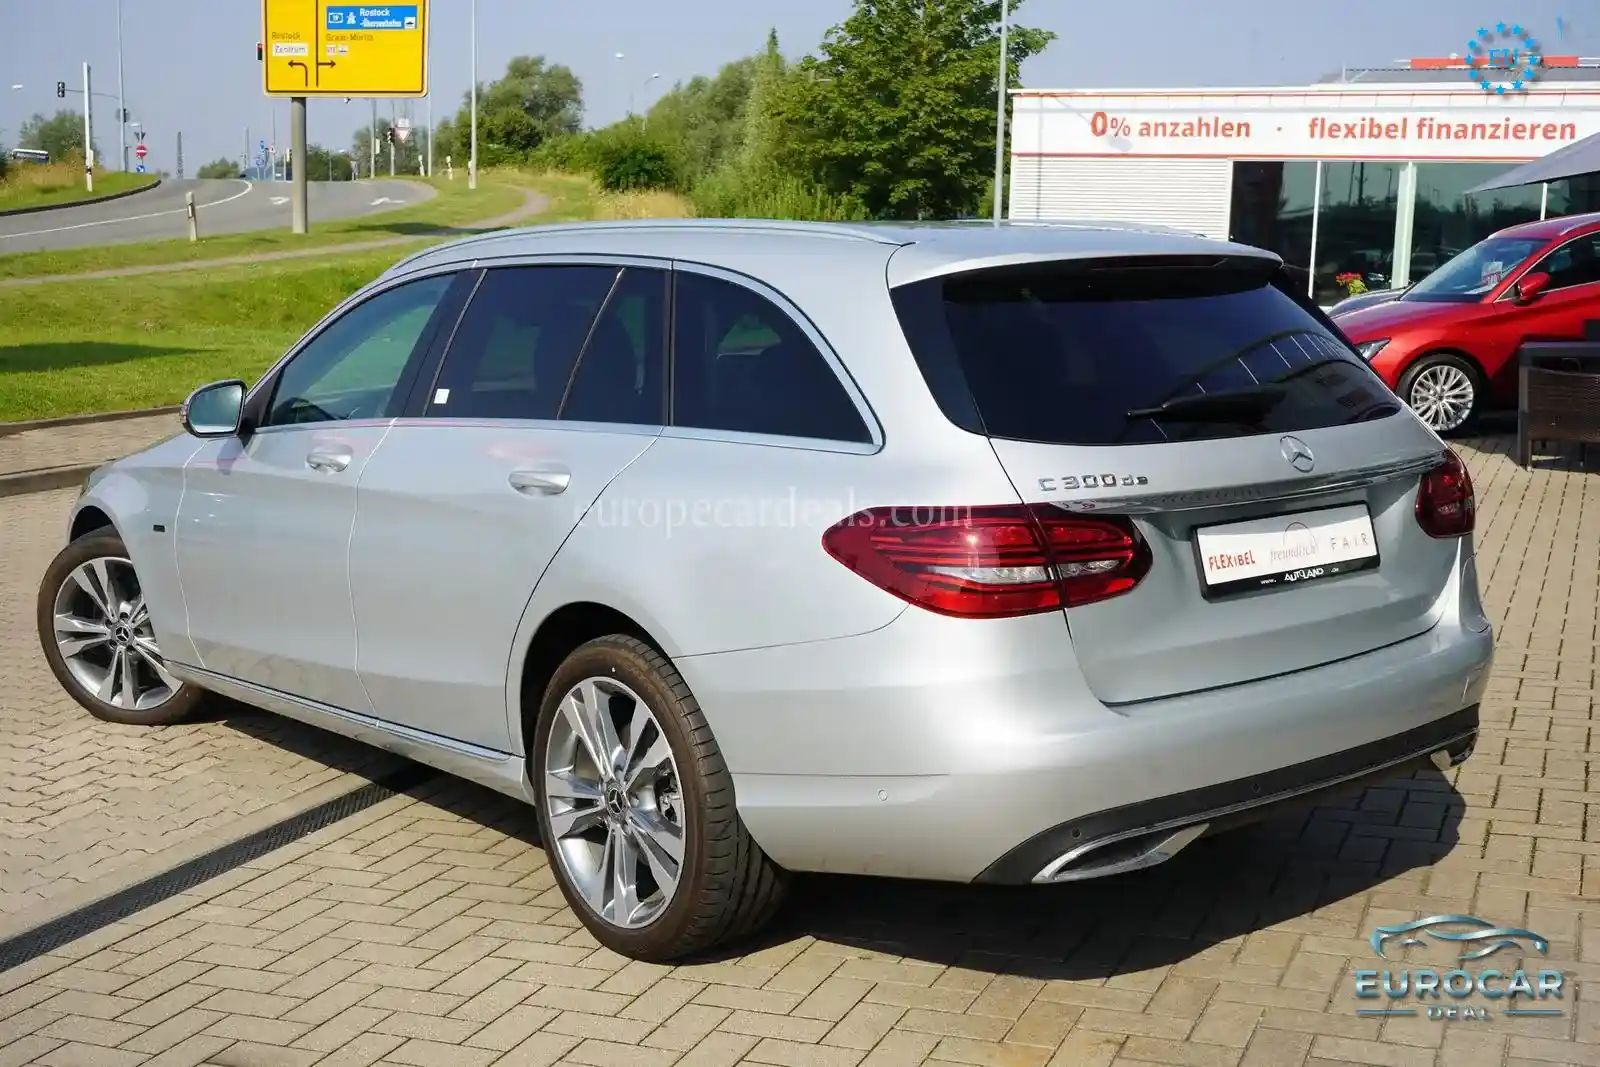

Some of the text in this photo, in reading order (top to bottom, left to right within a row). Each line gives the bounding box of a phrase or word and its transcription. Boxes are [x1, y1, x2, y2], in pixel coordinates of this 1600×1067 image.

[359, 7, 391, 17] Rostock
[1090, 111, 1251, 138] 0% anzahlen
[1308, 116, 1577, 141] flexibel finanzieren
[1208, 549, 1256, 572] FLEXIBEL
[1284, 567, 1324, 582] AUTOLAND
